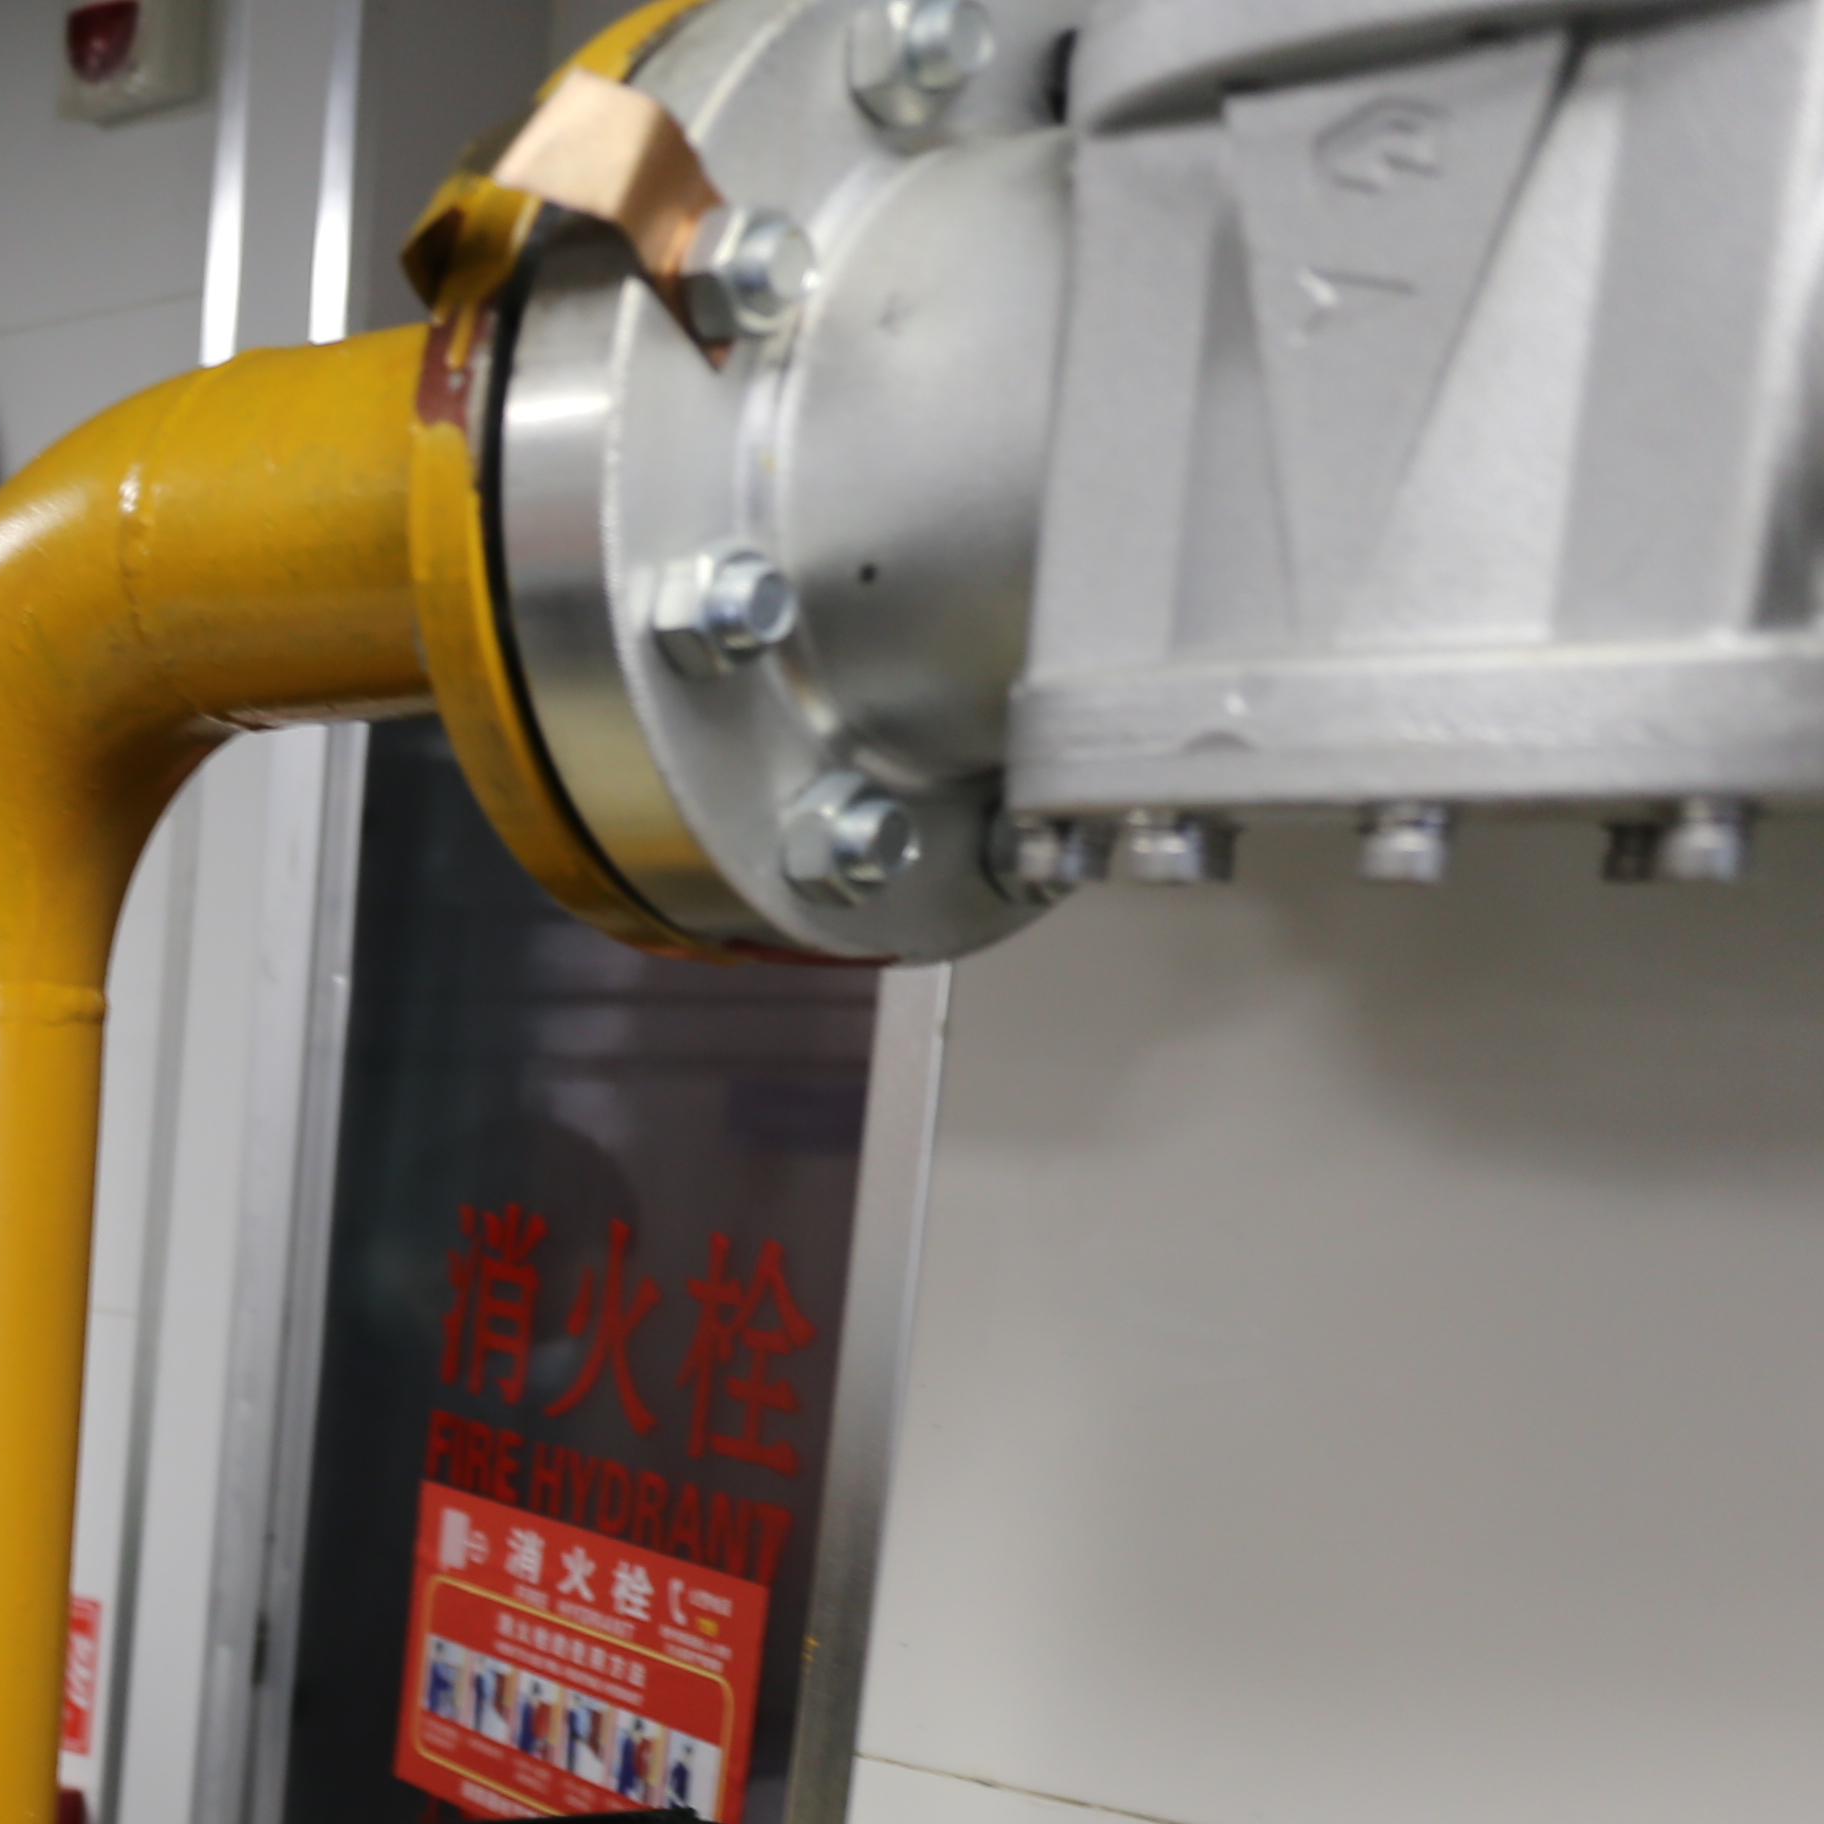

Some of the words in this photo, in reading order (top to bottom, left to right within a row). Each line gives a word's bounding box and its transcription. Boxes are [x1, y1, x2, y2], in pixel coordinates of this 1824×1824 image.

[438, 1202, 818, 1479] 消火栓
[425, 1409, 525, 1503] FIRE
[528, 1440, 794, 1588] HYDRANT
[505, 1526, 655, 1622] 消火栓
